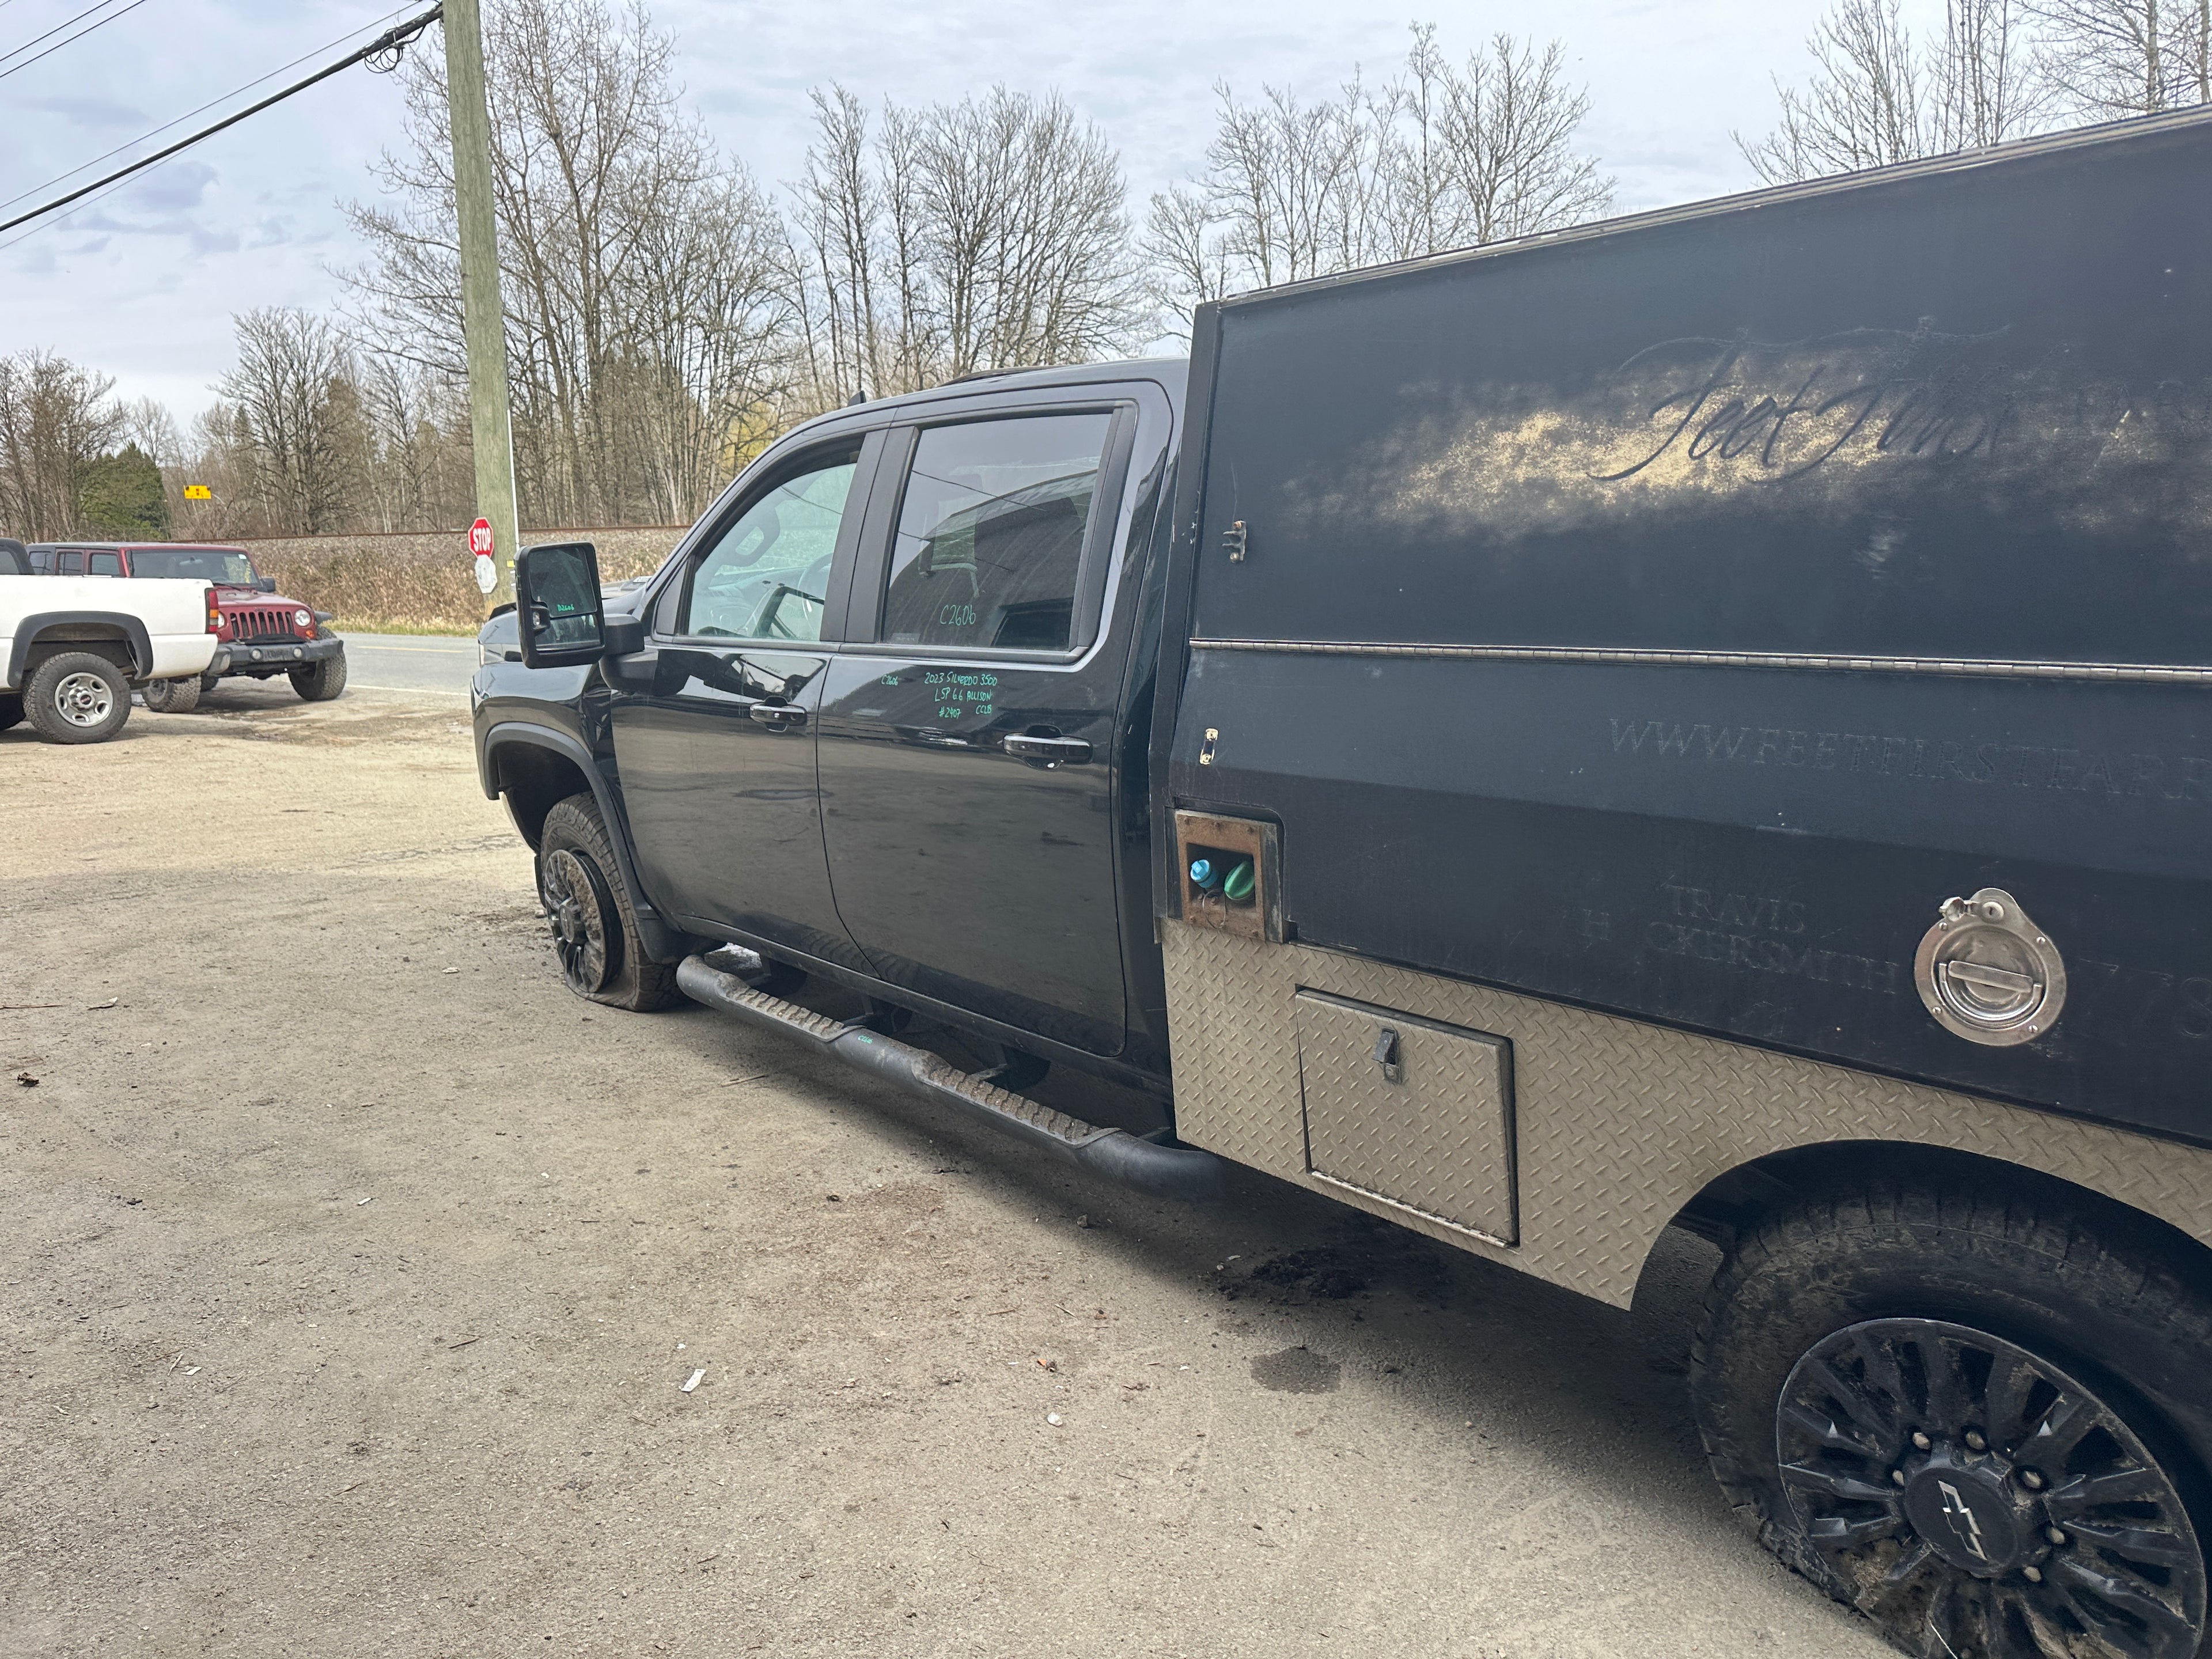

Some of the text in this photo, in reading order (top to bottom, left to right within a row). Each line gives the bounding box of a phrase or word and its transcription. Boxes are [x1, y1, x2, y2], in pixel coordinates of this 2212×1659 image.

[473, 527, 491, 552] STOP
[924, 672, 945, 684] 2023
[980, 673, 998, 686] 3500
